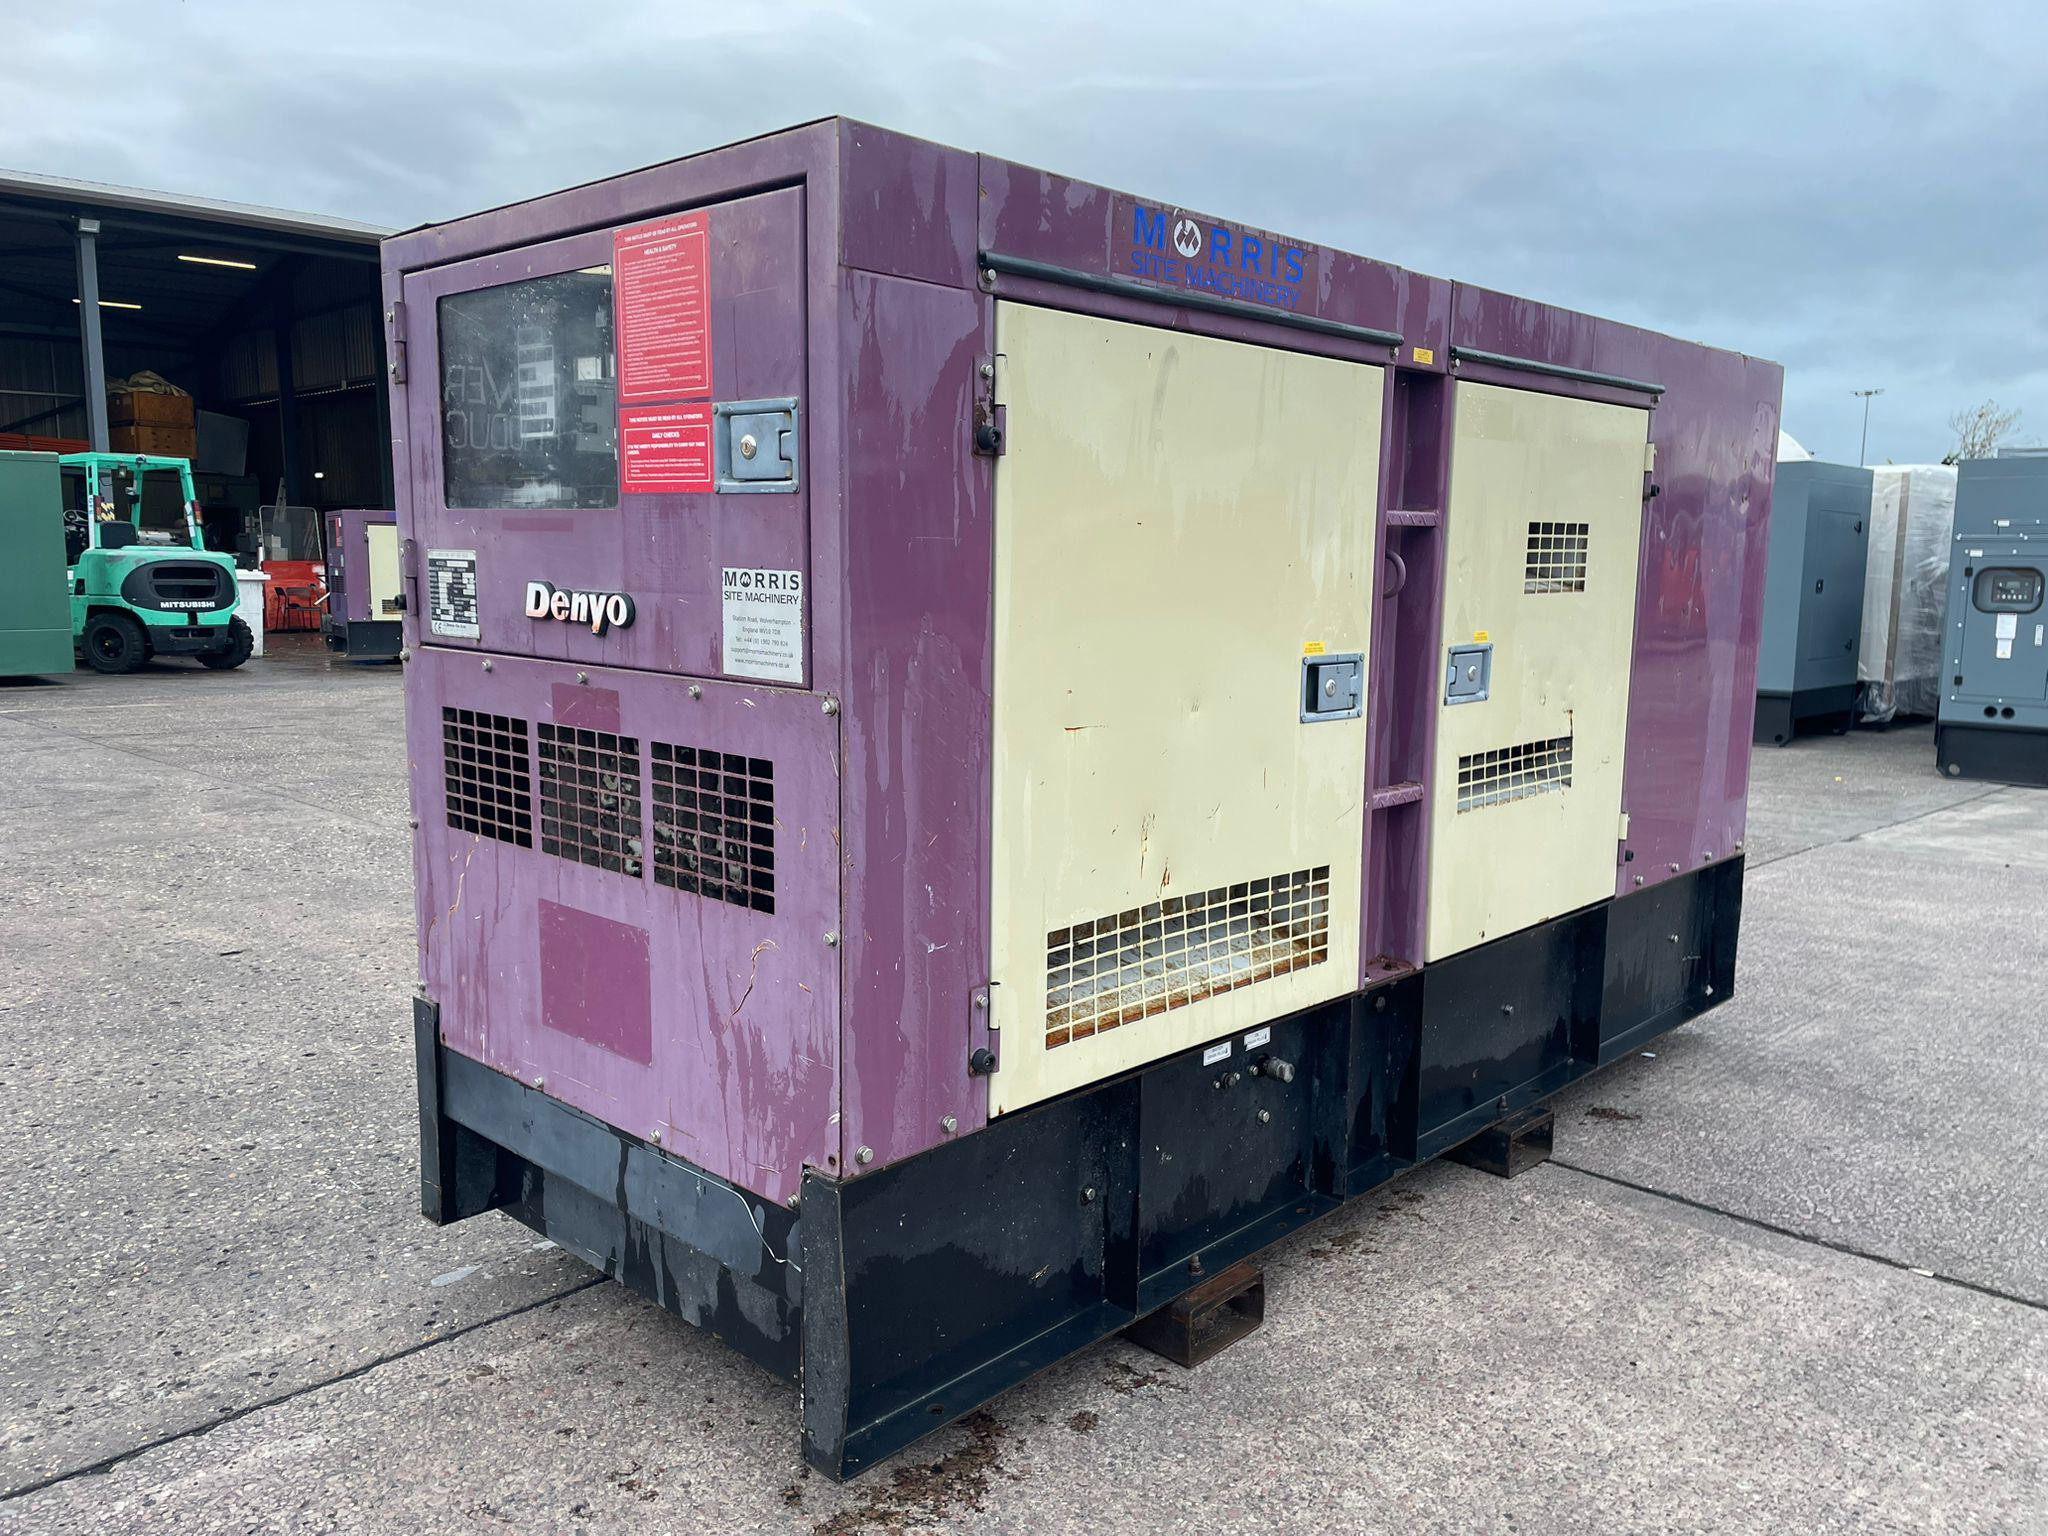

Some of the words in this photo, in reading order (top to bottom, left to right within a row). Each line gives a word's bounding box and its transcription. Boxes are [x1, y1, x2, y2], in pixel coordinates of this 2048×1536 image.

[1133, 207, 1304, 284] MORRIS
[1132, 251, 1180, 283] SITE
[1185, 262, 1301, 309] MACHINERY
[724, 571, 800, 590] MORRIS
[724, 591, 743, 601] SITE
[745, 592, 799, 605] MACHINERY
[526, 581, 633, 636] Denyo
[742, 626, 759, 634] England
[760, 617, 791, 626] Wolverhampton
